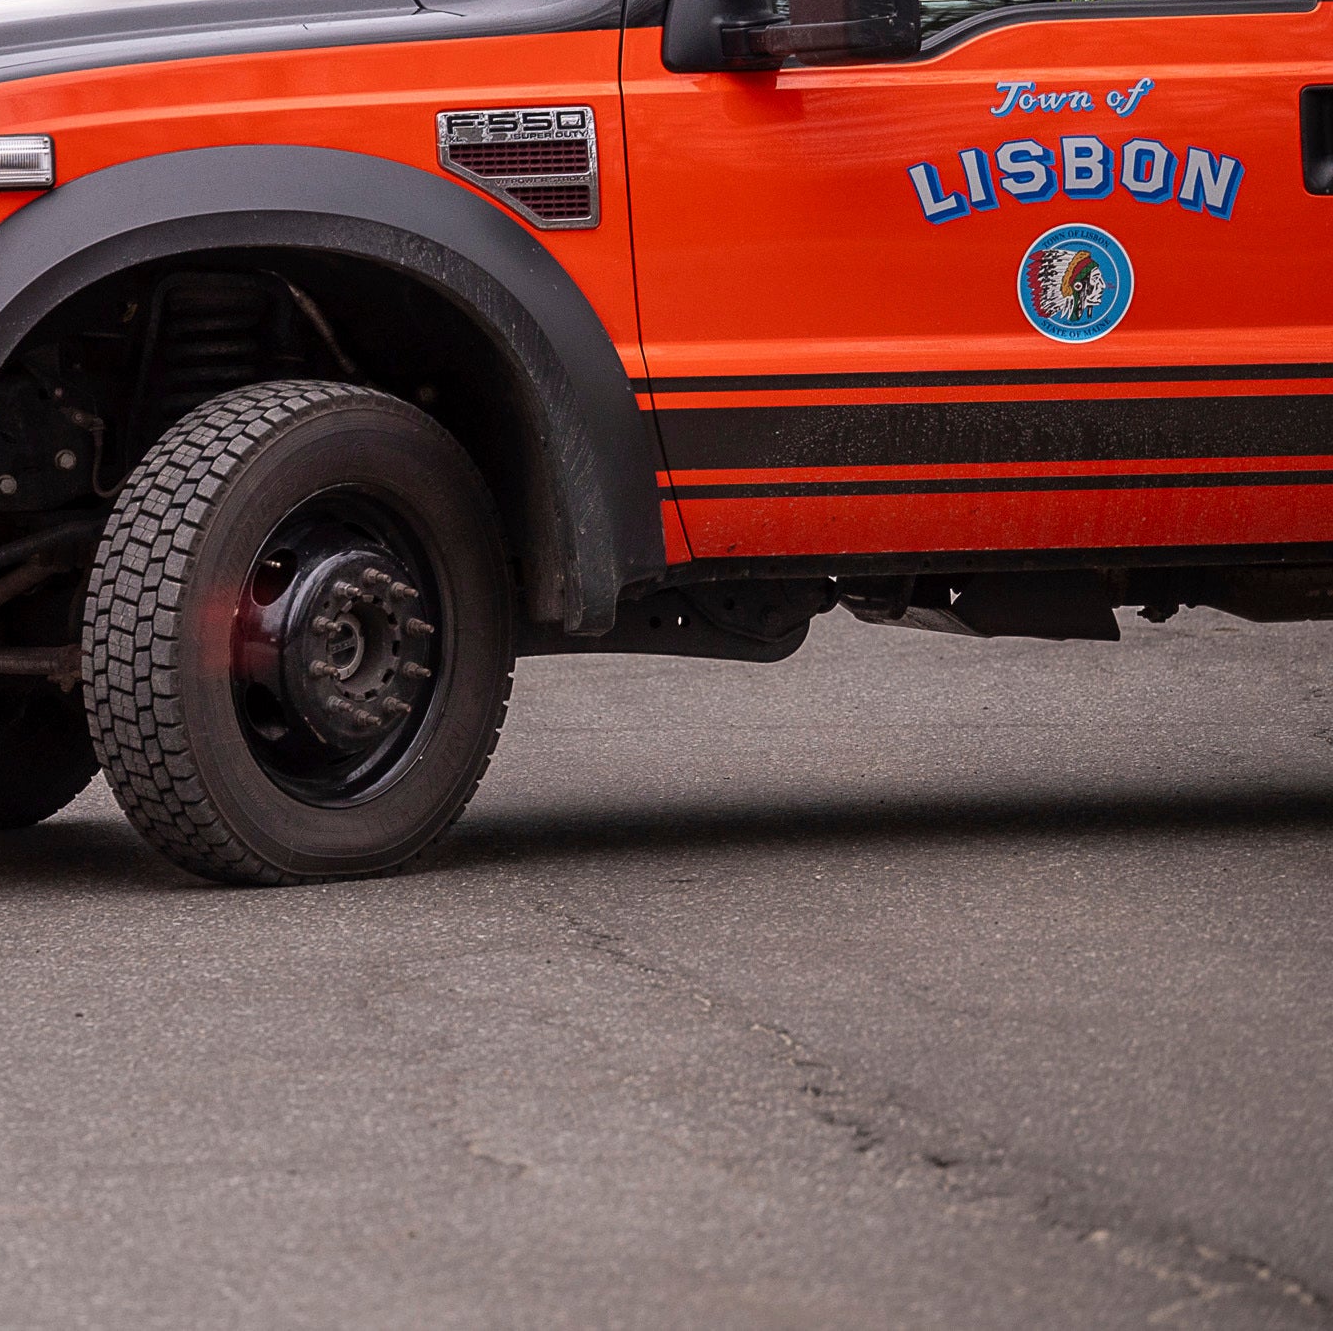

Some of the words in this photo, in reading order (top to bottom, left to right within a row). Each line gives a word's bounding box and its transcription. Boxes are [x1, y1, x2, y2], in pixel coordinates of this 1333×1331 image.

[990, 80, 1095, 118] Town
[1106, 77, 1155, 118] of
[447, 110, 586, 135] F-550
[513, 132, 552, 140] SUPER
[555, 130, 588, 139] DUTY
[907, 134, 1246, 225] LISBON
